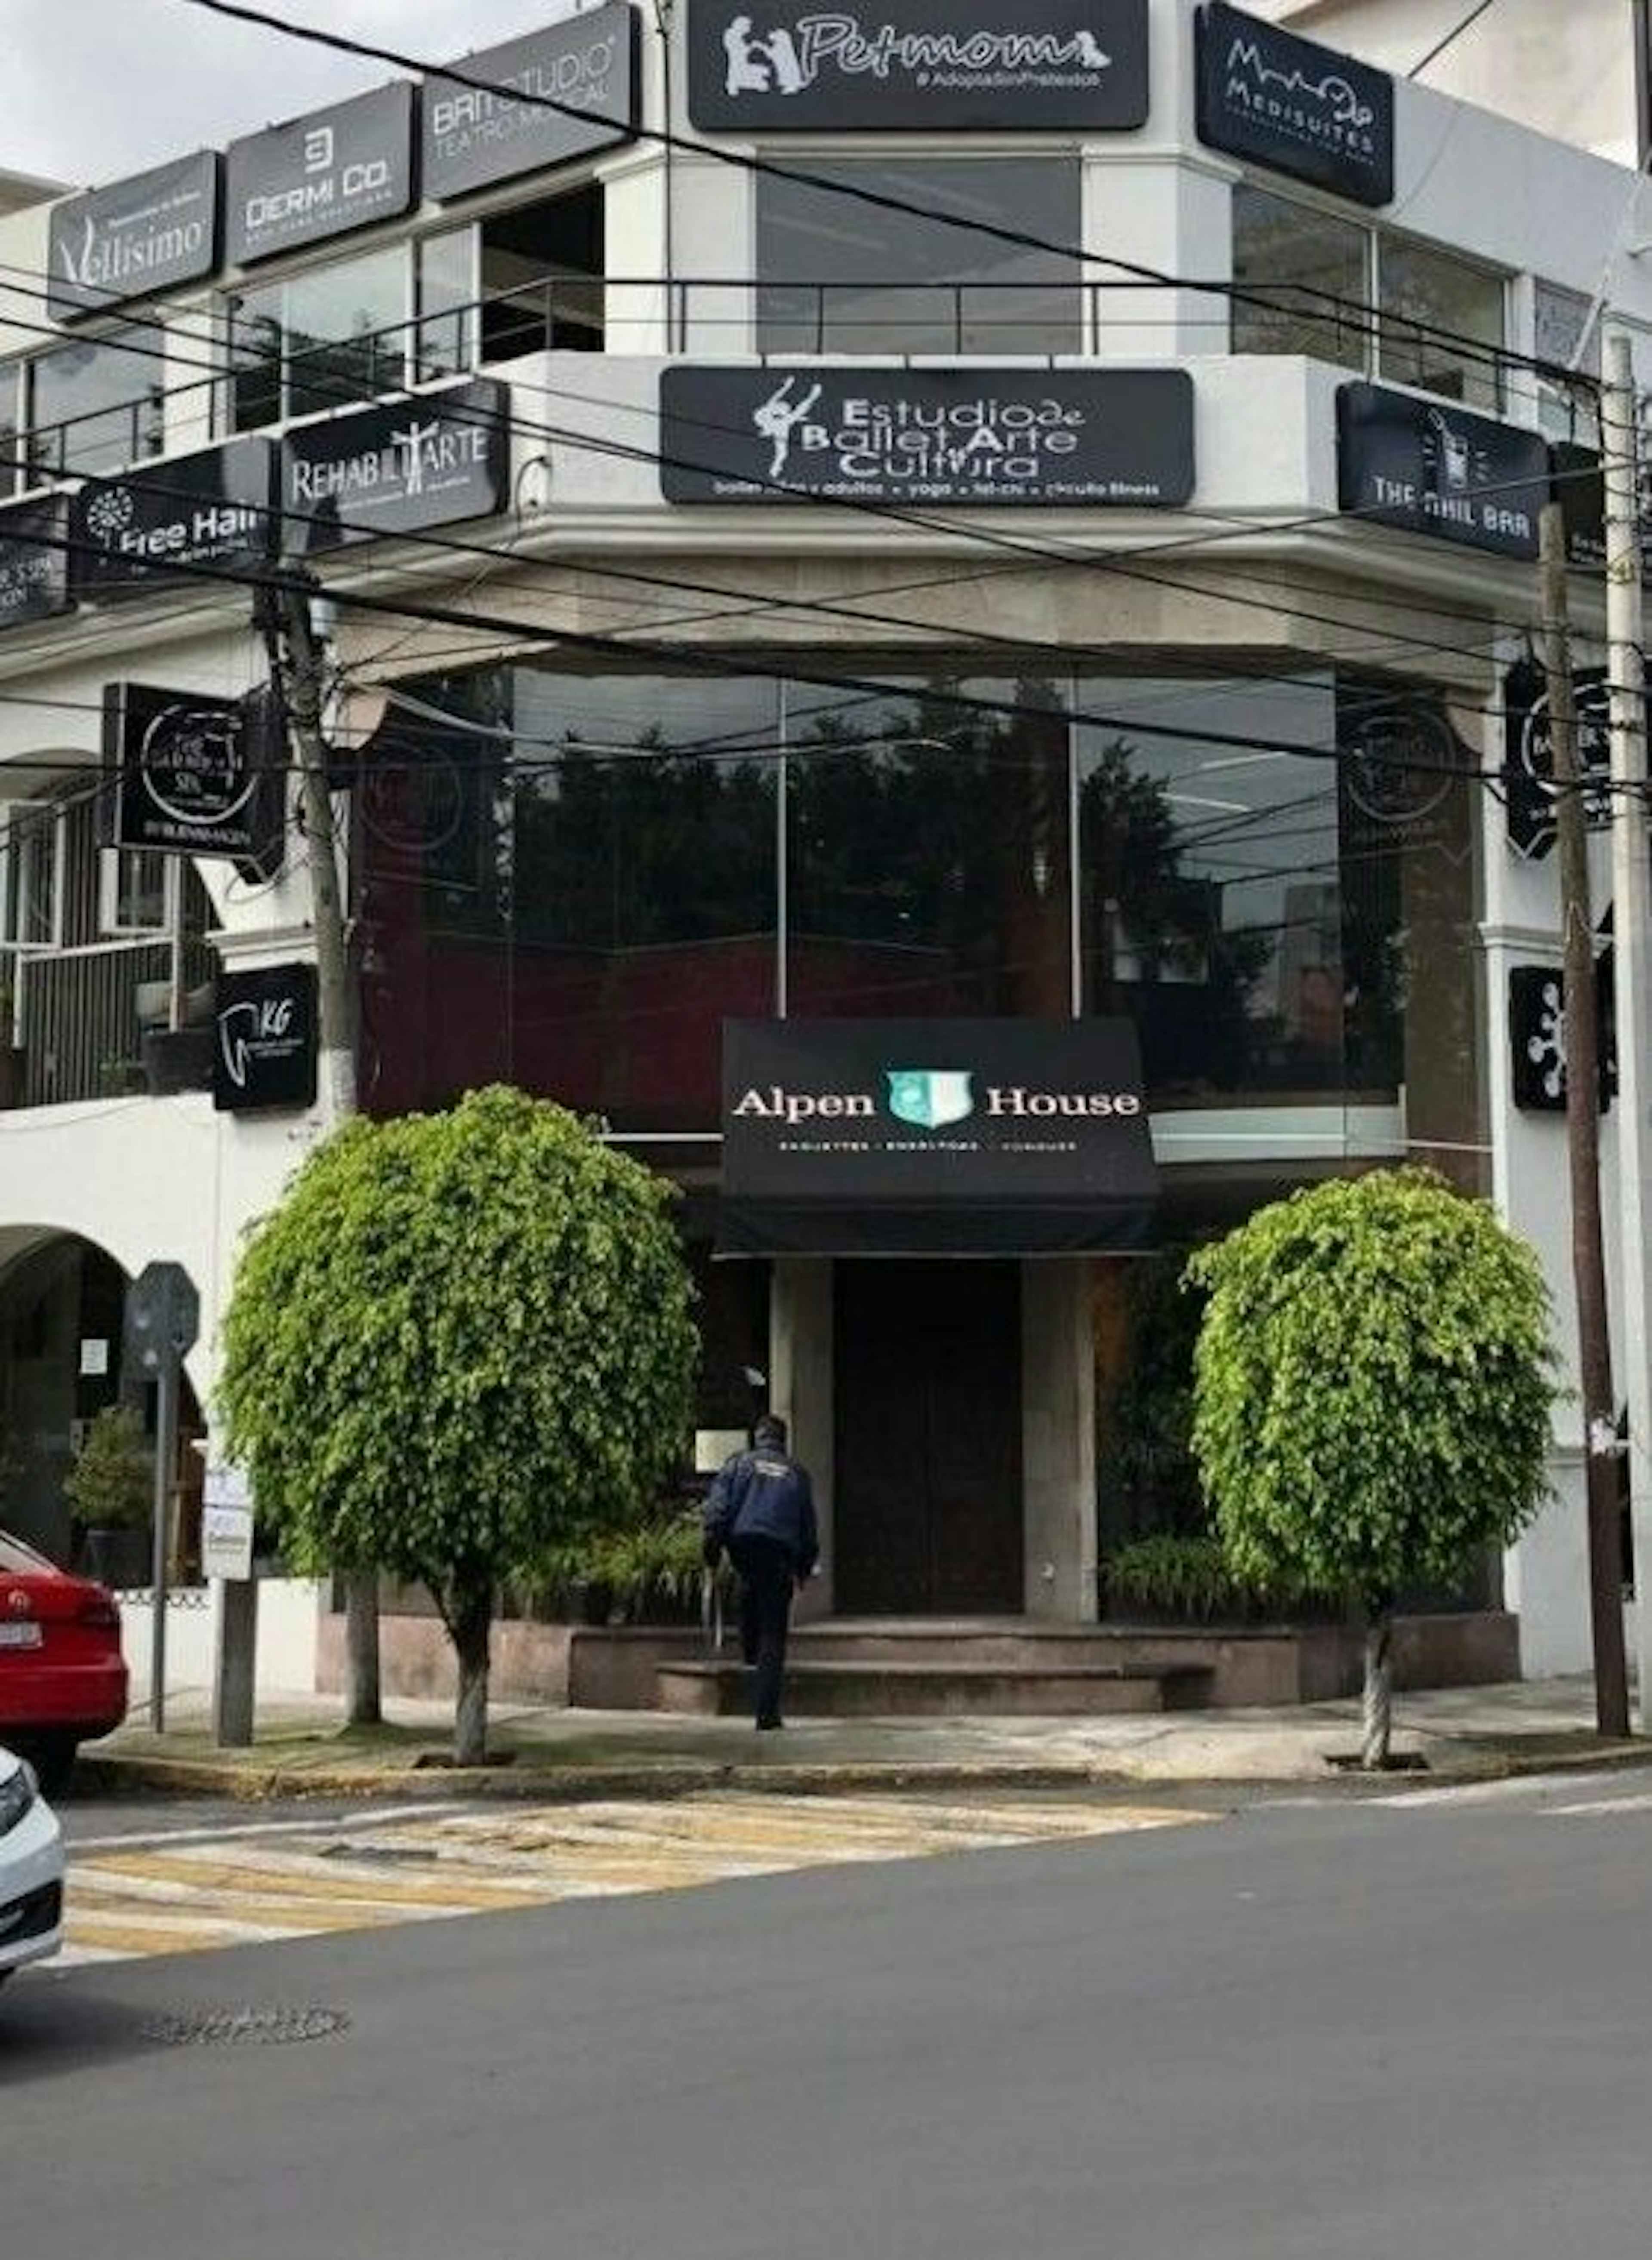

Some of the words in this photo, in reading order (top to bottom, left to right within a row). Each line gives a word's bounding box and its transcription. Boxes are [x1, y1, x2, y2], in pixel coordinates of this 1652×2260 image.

[246, 179, 333, 228] DERMI
[842, 398, 1033, 428] Estudio
[801, 424, 950, 453] Ballet
[965, 425, 1078, 454] Arte
[838, 450, 1039, 477] Cultura
[733, 1085, 876, 1124] Alpen
[985, 1087, 1141, 1116] House
